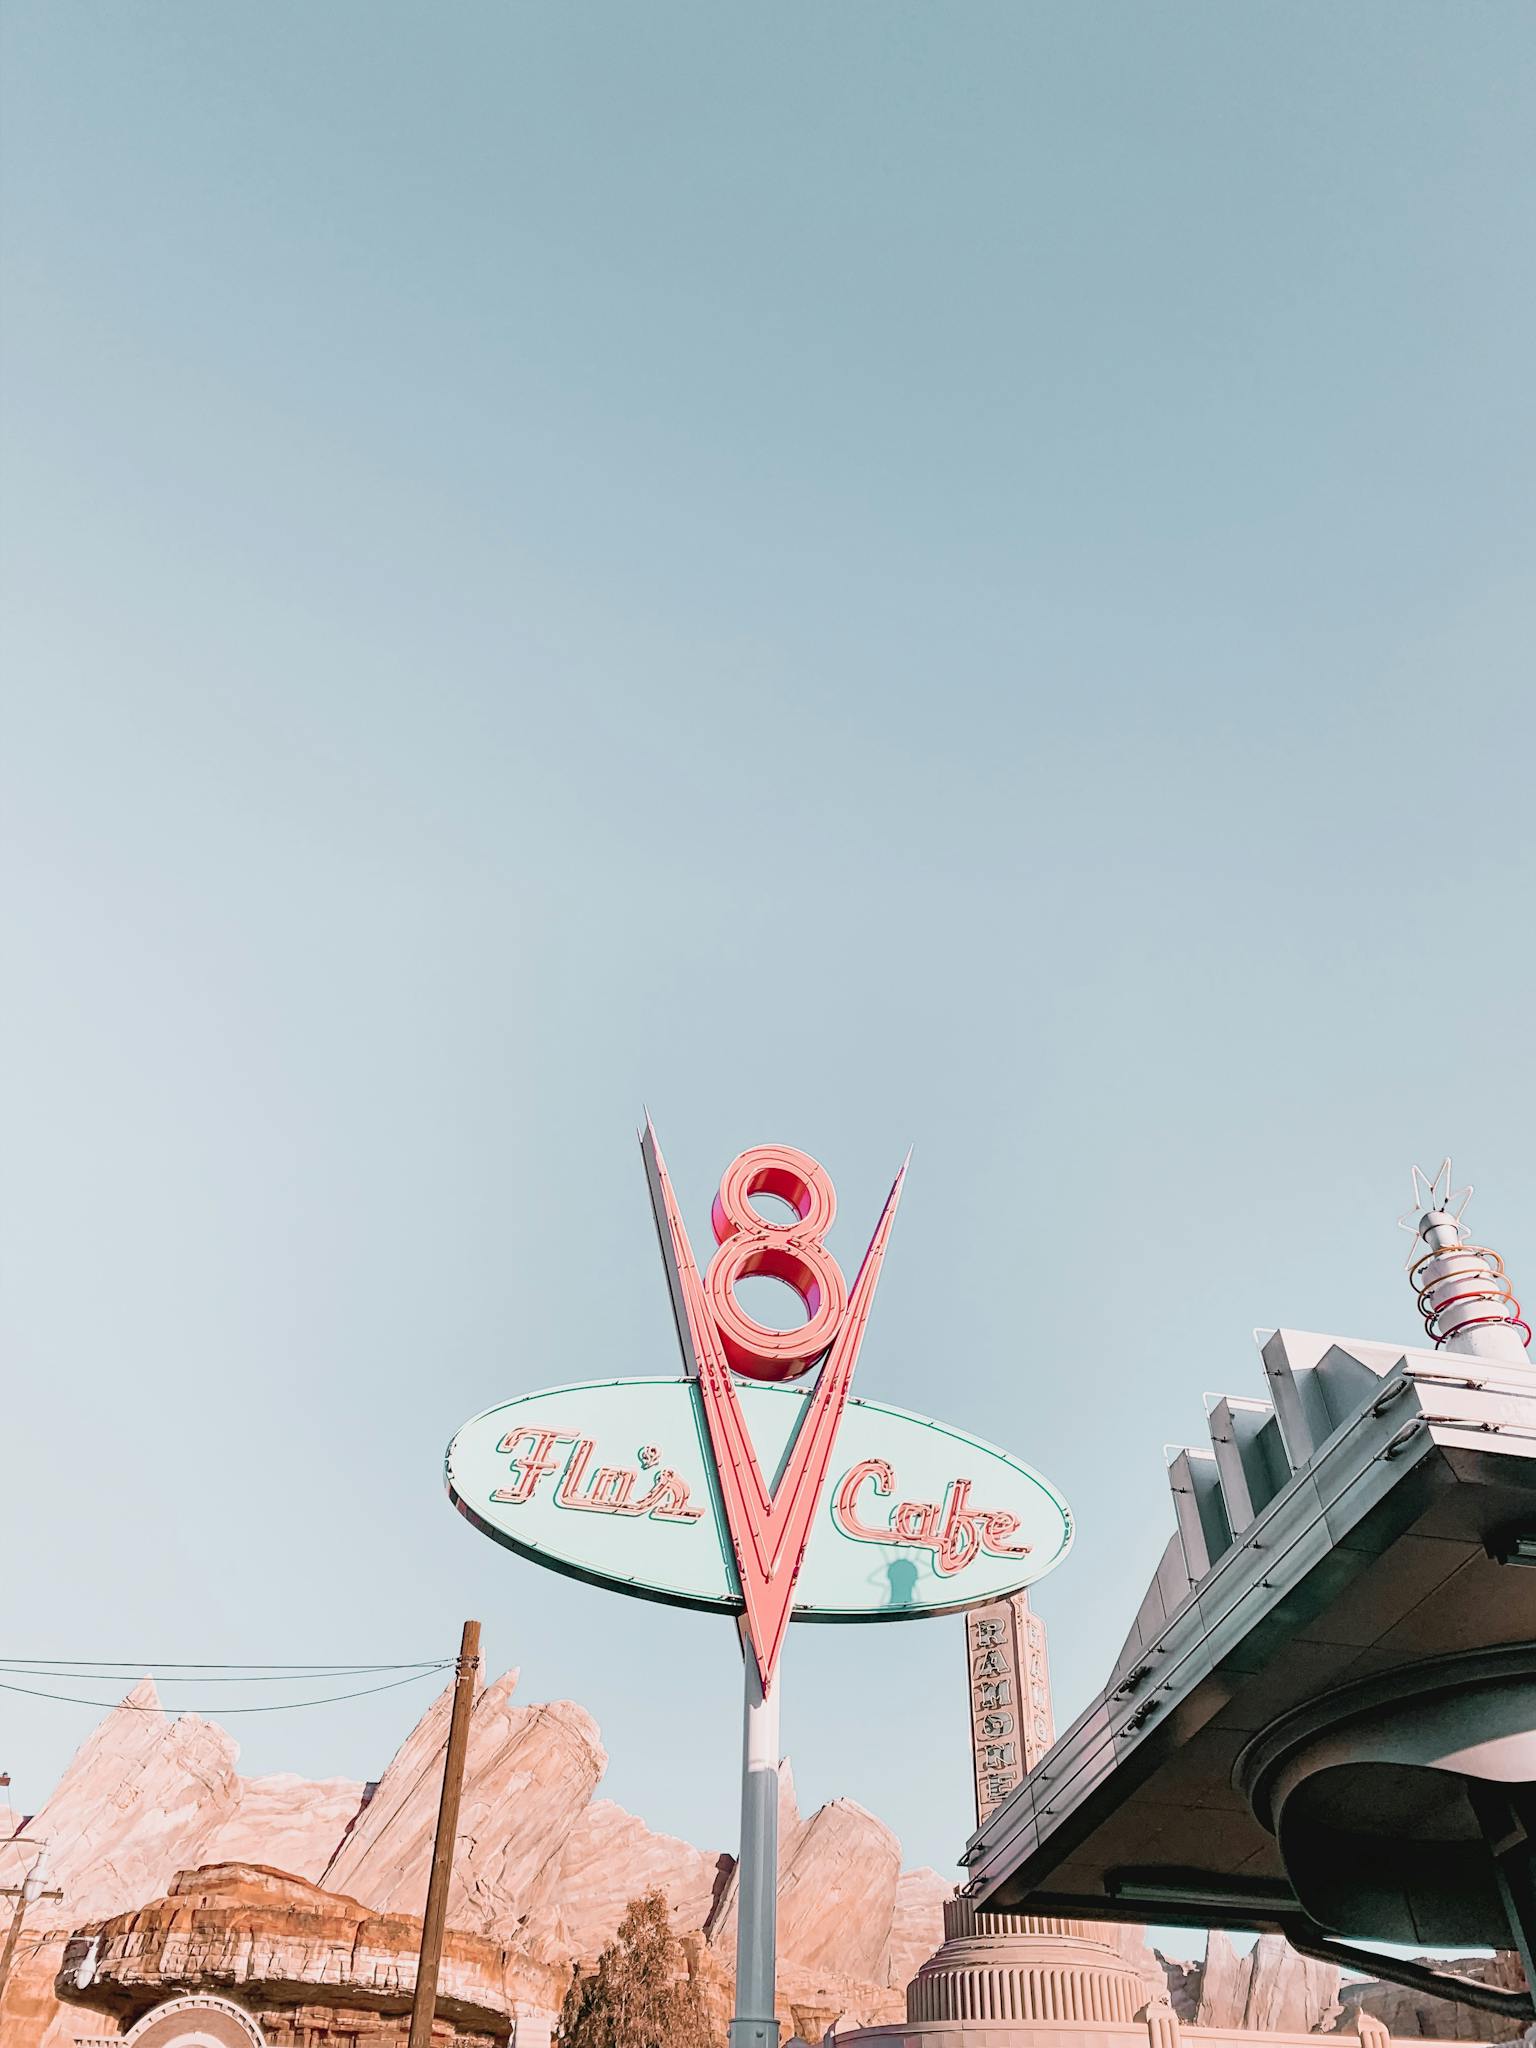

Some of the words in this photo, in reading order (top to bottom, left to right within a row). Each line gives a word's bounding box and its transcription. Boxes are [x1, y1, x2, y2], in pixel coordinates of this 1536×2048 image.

[490, 1425, 706, 1525] Flo's
[831, 1457, 1034, 1578] Cafe
[973, 1618, 1017, 1818] RAMONE
